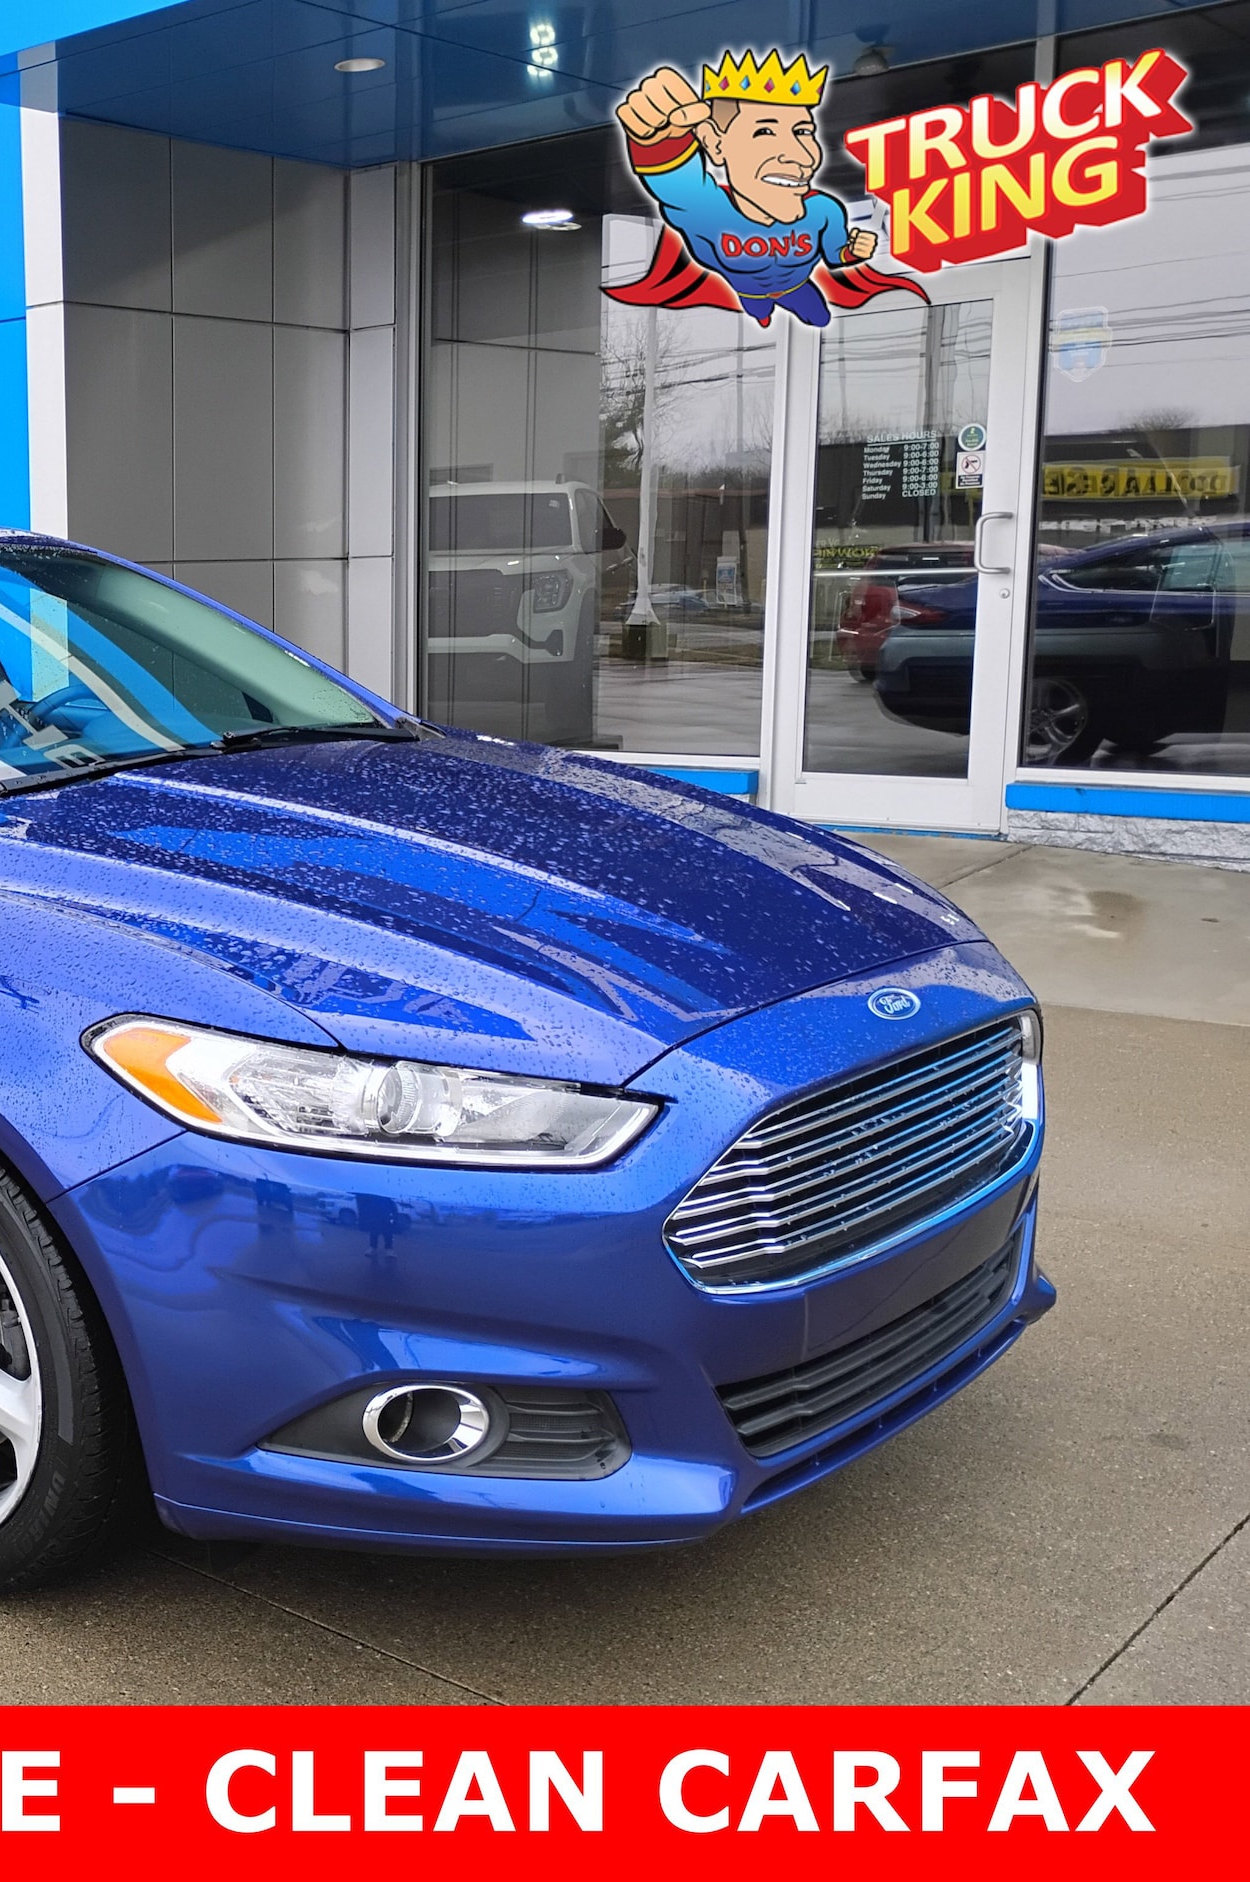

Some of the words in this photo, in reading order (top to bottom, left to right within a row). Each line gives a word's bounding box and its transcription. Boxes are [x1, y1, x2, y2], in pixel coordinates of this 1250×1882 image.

[867, 433, 899, 443] SALES
[902, 430, 937, 440] HOURS
[863, 461, 901, 469] Wednesday
[902, 489, 936, 497] CLOSED
[878, 994, 911, 1015] Ford
